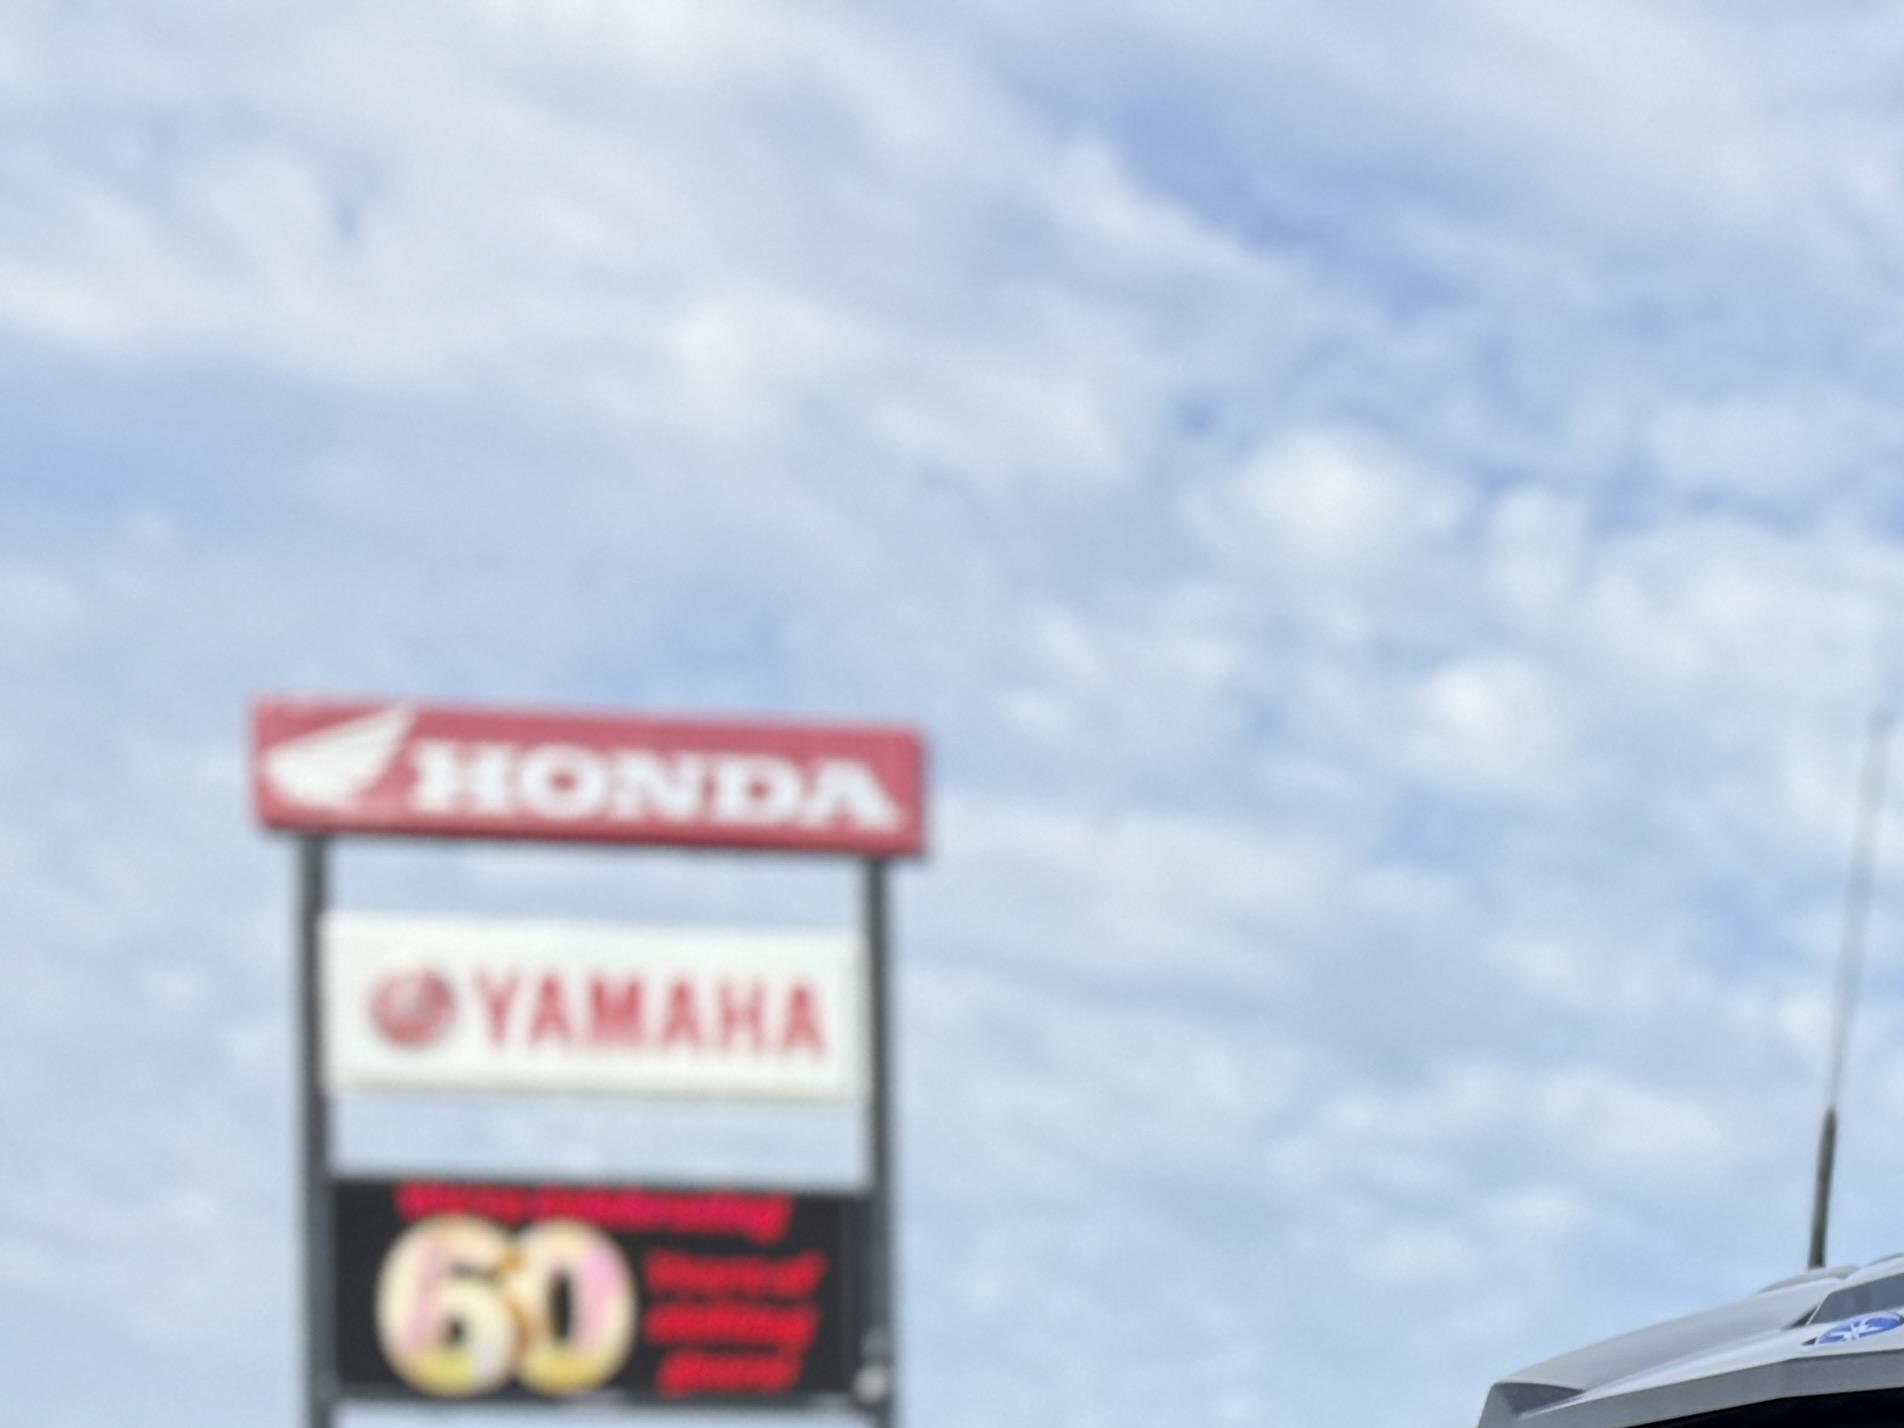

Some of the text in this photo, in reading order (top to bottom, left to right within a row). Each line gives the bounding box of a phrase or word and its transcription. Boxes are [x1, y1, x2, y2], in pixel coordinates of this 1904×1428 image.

[412, 741, 902, 832] HONDA
[476, 970, 828, 1060] YAMAHA
[378, 1214, 635, 1397] 60
